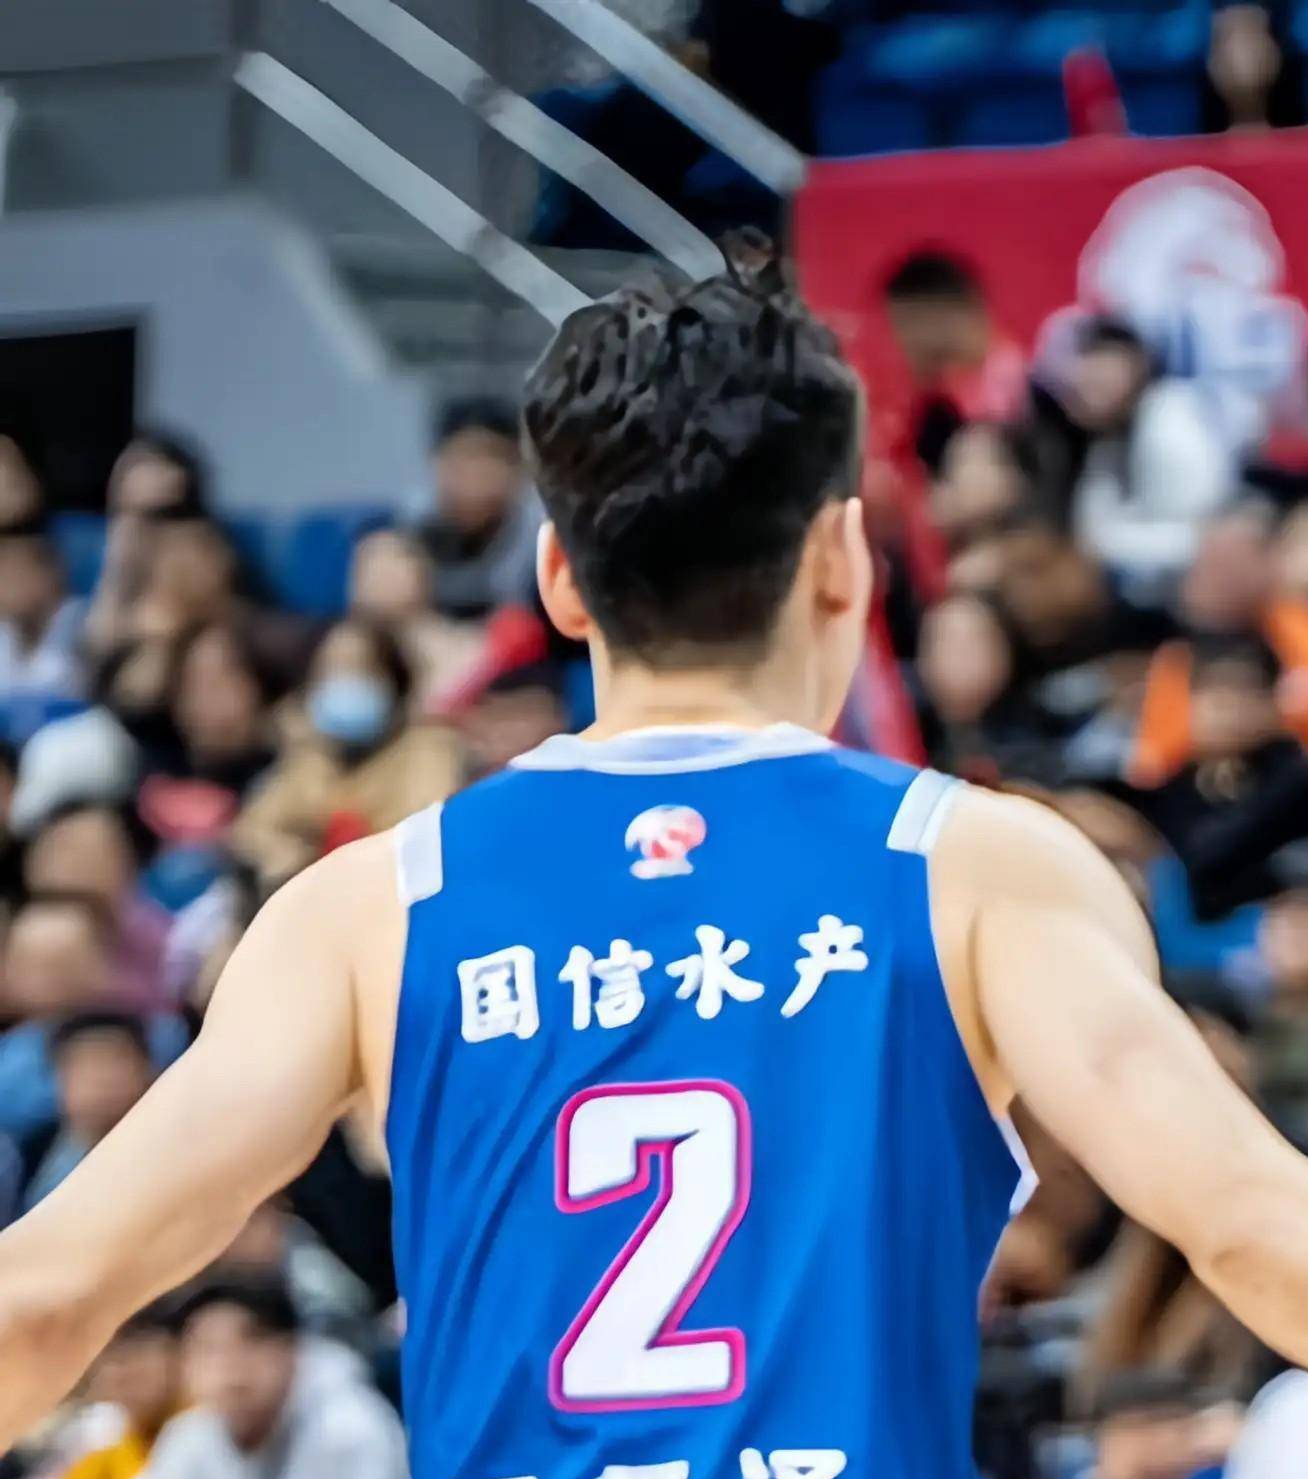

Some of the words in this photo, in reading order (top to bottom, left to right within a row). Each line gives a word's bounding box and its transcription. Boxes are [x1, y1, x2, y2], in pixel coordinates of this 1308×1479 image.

[456, 913, 869, 1043] 国信水产
[549, 1078, 751, 1412] 2
